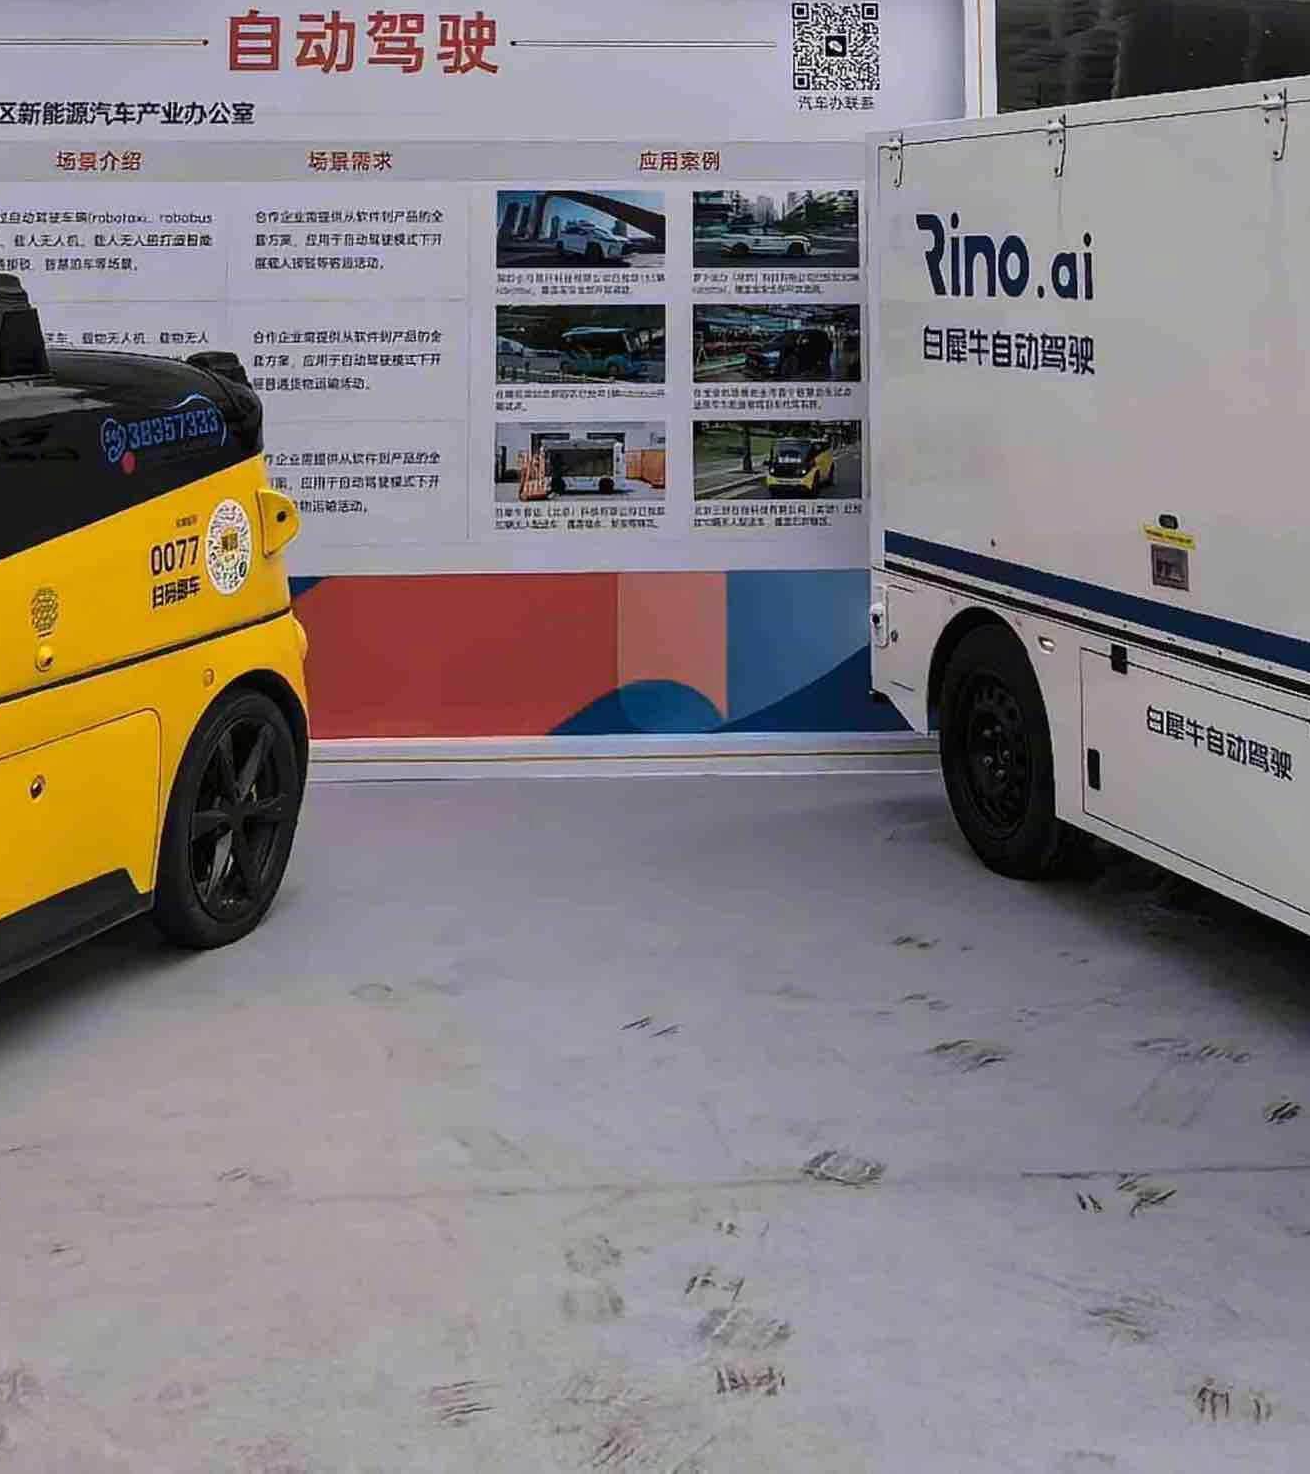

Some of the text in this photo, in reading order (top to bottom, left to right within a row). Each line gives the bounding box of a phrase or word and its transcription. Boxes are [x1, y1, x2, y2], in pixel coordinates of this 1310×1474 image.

[227, 8, 500, 75] 自动驾驶
[56, 151, 142, 172] 场景介绍
[307, 150, 394, 172] 场景需求
[639, 150, 722, 173] 应用案例
[915, 211, 1094, 300] Rino.ai
[922, 324, 1096, 375] 白犀牛自动驾驶
[149, 535, 200, 576] 0077
[1145, 703, 1295, 782] 白犀牛自动驾驶
